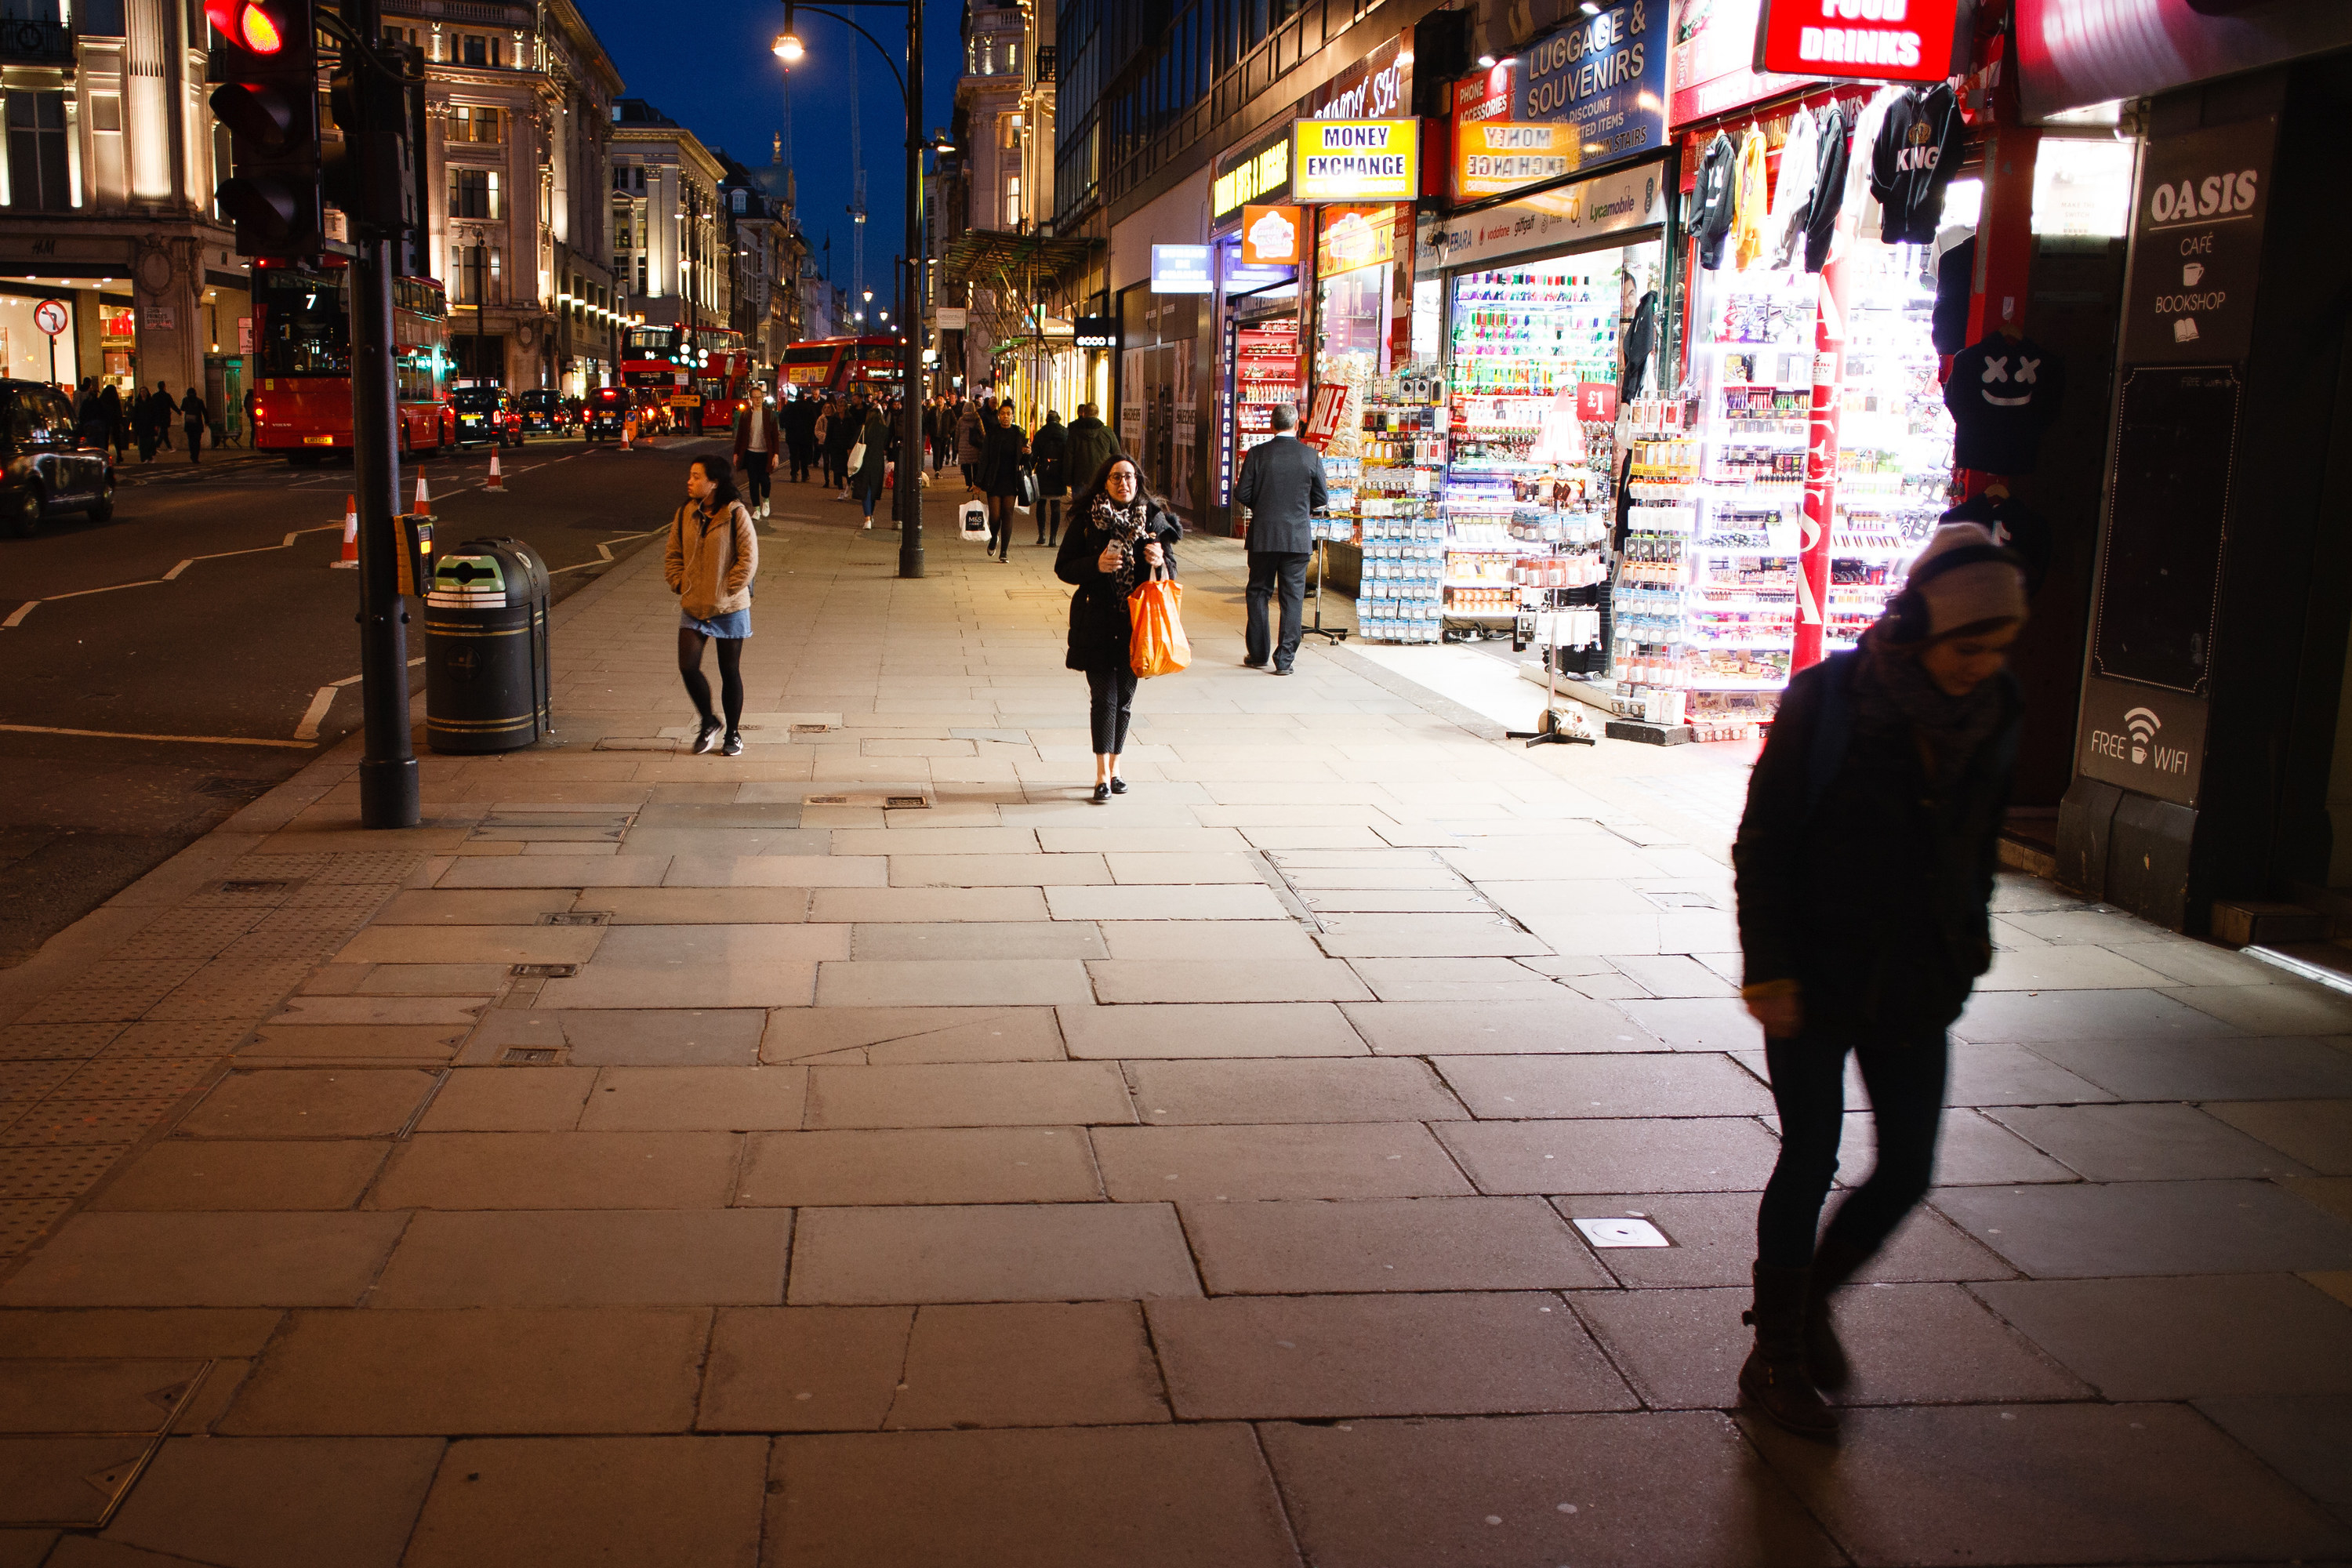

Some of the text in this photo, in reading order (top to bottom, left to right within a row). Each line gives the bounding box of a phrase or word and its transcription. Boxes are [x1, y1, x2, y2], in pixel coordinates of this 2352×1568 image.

[1529, 0, 1646, 81] LUGGAGE &
[1799, 26, 1921, 67] DRINKS
[1459, 80, 1484, 105] PHONE
[1527, 42, 1645, 118] SOUVENIRS
[1458, 93, 1508, 129] ACCESSORIES
[1569, 96, 1612, 123] DISCOUNT
[1598, 111, 1624, 132] ITEMS
[1324, 127, 1388, 147] MONEY
[1614, 125, 1647, 152] STAIRS
[1308, 156, 1404, 176] EXCHANGE
[1896, 146, 1940, 172] KING
[2151, 169, 2257, 222] OASIS
[1487, 225, 1510, 241] vodafone
[1514, 214, 1536, 237] giffgaff
[1549, 214, 1562, 225] Three
[1590, 194, 1635, 223] Lycamobile
[31, 238, 56, 255] H&M
[2180, 231, 2214, 256] CAFÉ
[306, 294, 317, 310] 7
[2155, 292, 2226, 314] BOOKSHOP
[1308, 387, 1345, 436] SALE
[1588, 390, 1605, 415] £1
[1221, 393, 1230, 505] EXCHANGE
[1701, 699, 1719, 708] RAW
[2091, 730, 2189, 775] FREE WIFI
